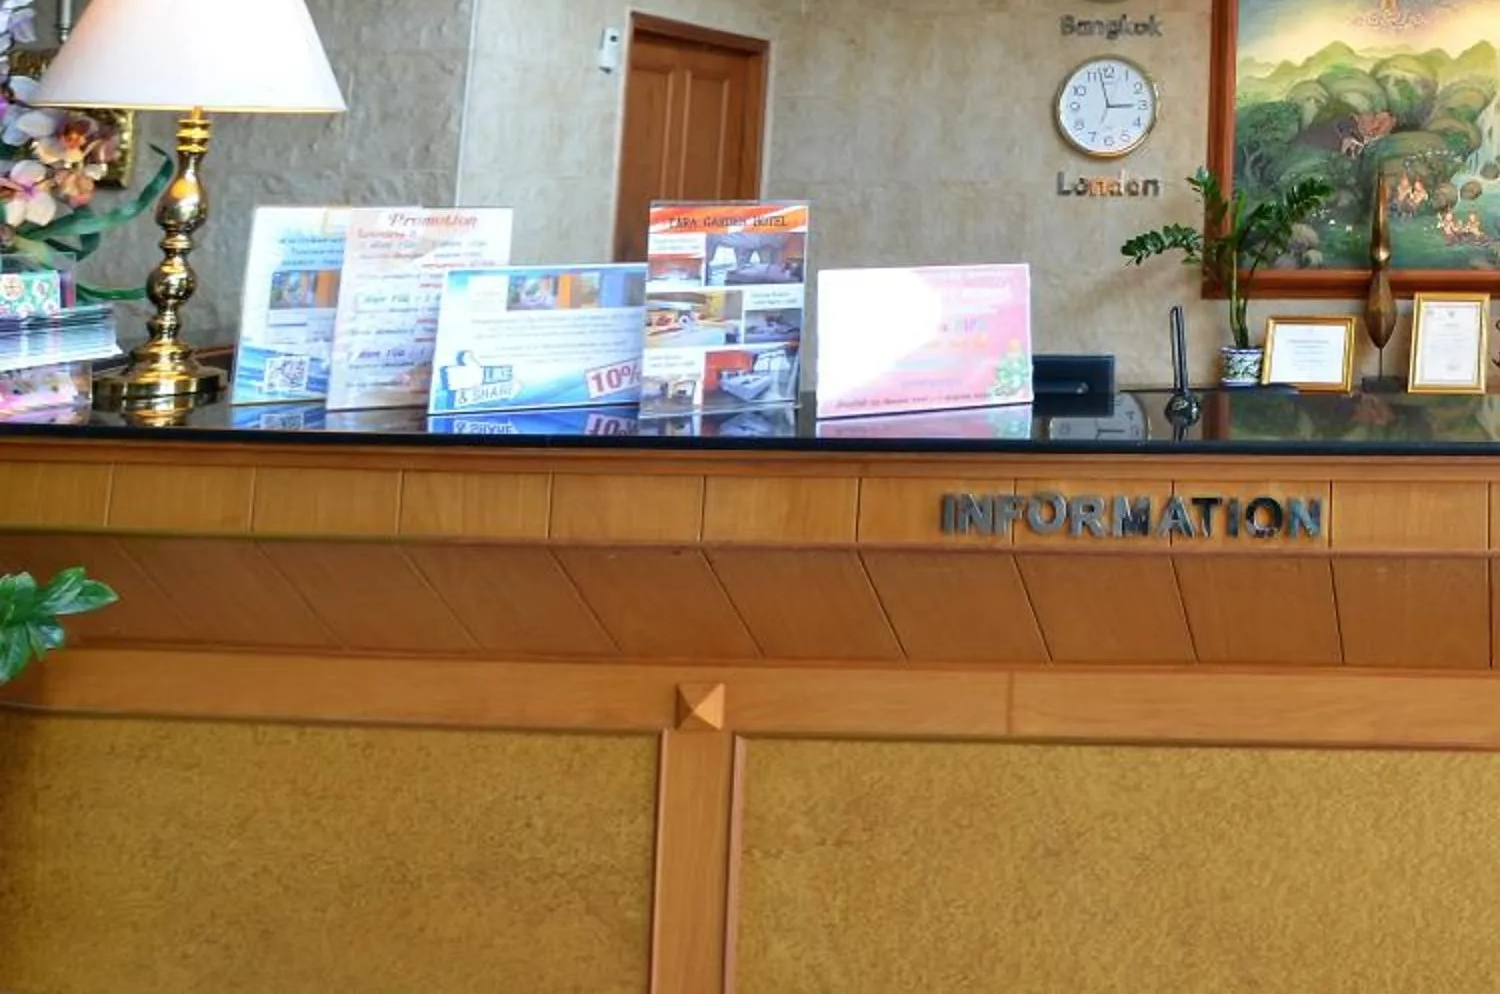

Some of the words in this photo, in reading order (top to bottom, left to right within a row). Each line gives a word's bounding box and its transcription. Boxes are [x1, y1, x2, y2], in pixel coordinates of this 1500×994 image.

[1060, 14, 1163, 40] Bangkok
[1057, 169, 1160, 197] London
[940, 492, 1323, 539] INFORMATION
